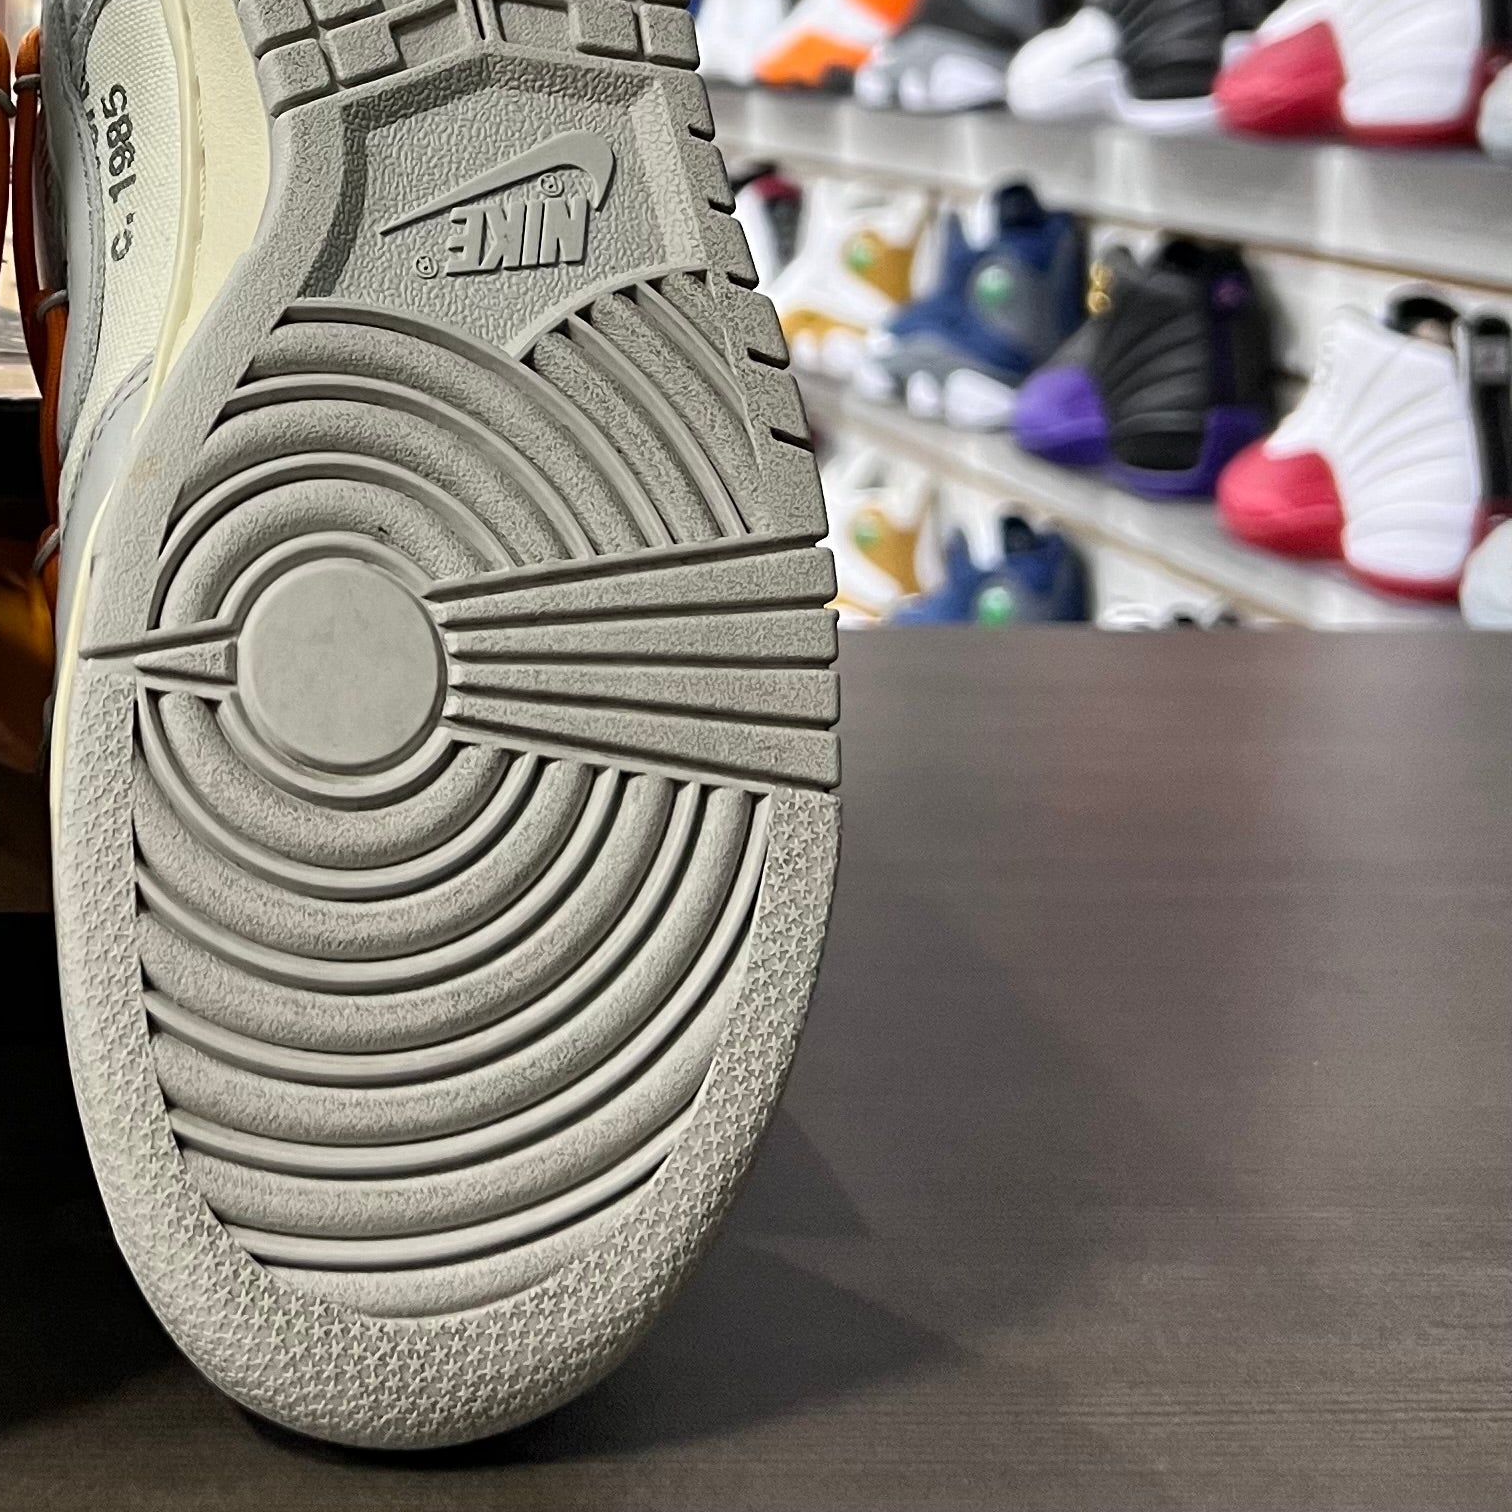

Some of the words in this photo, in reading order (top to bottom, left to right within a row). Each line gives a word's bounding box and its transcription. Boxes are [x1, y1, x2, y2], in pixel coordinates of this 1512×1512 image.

[100, 83, 137, 204] 1985
[110, 212, 136, 261] c.
[445, 197, 589, 276] NIKE
